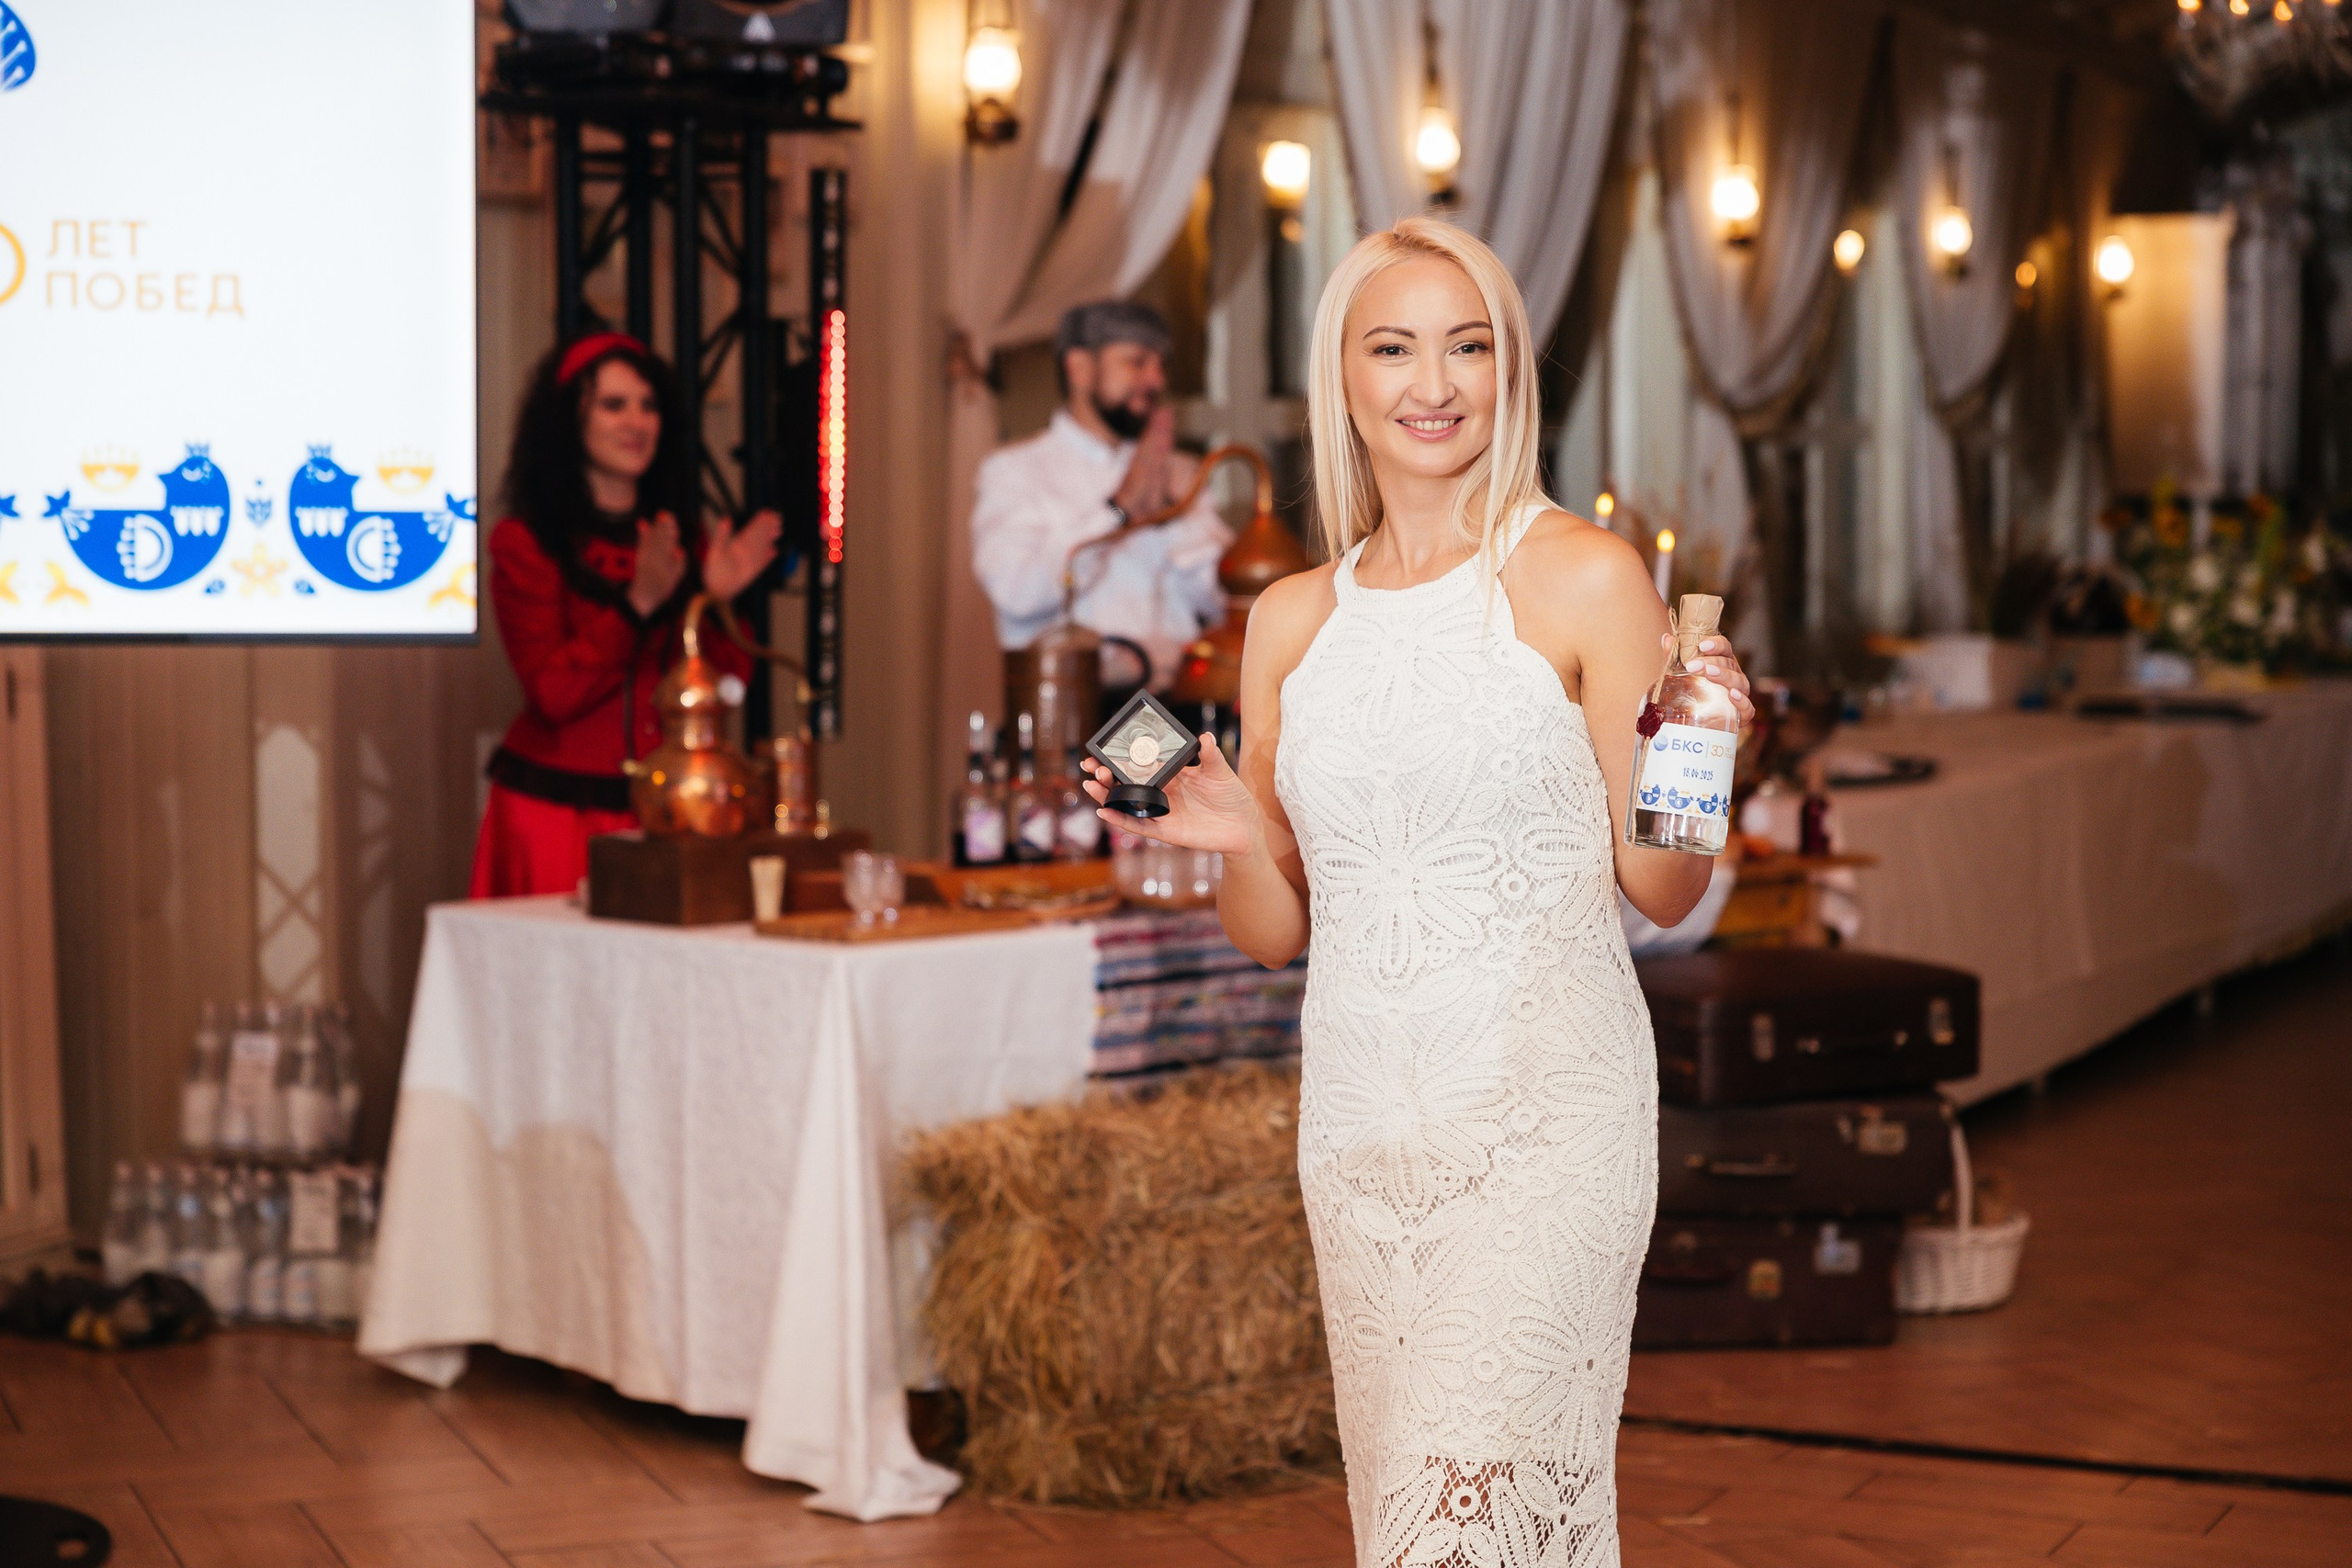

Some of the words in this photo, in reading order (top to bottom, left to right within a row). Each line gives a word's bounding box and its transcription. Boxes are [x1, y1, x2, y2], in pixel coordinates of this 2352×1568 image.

[48, 219, 145, 258] ЛЕТ
[46, 271, 245, 318] ПОБЕД
[1671, 739, 1703, 754] БКС
[1711, 744, 1724, 757] 30
